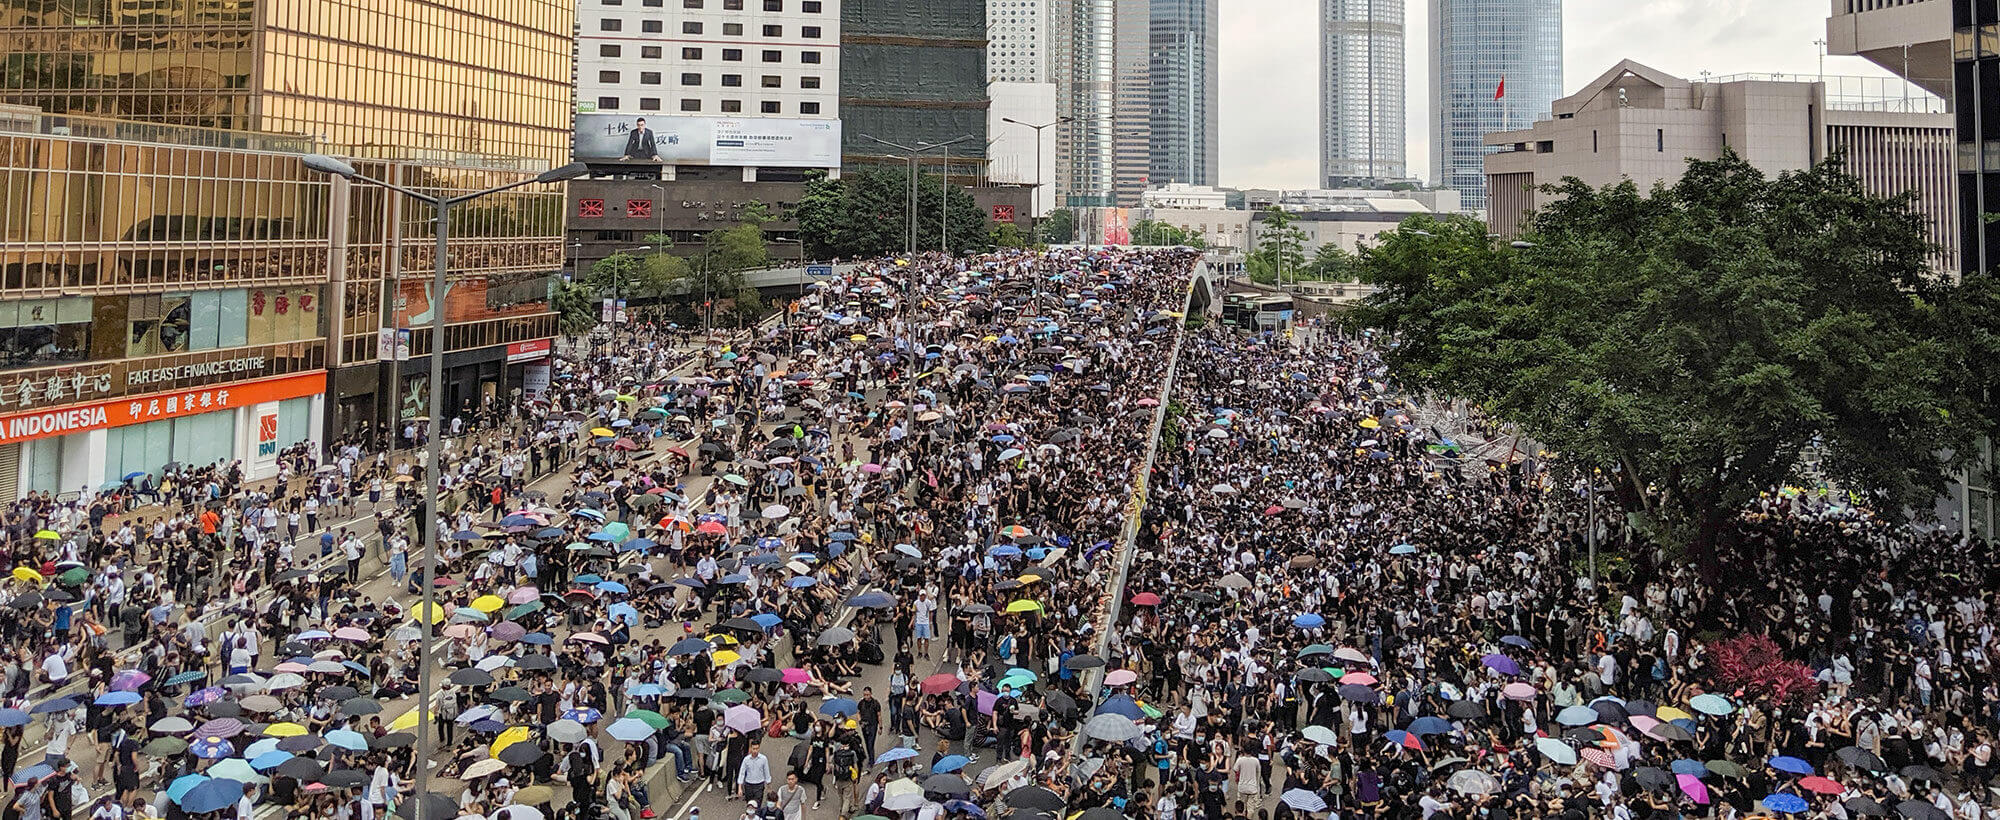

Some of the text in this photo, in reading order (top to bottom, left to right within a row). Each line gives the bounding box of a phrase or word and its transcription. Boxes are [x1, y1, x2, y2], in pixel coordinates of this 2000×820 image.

[128, 356, 265, 385] FAR EAST FINANCE CENTRE
[129, 390, 230, 420] 印尼國家銀行
[9, 406, 108, 438] INDONESIA
[258, 441, 276, 457] BNI
